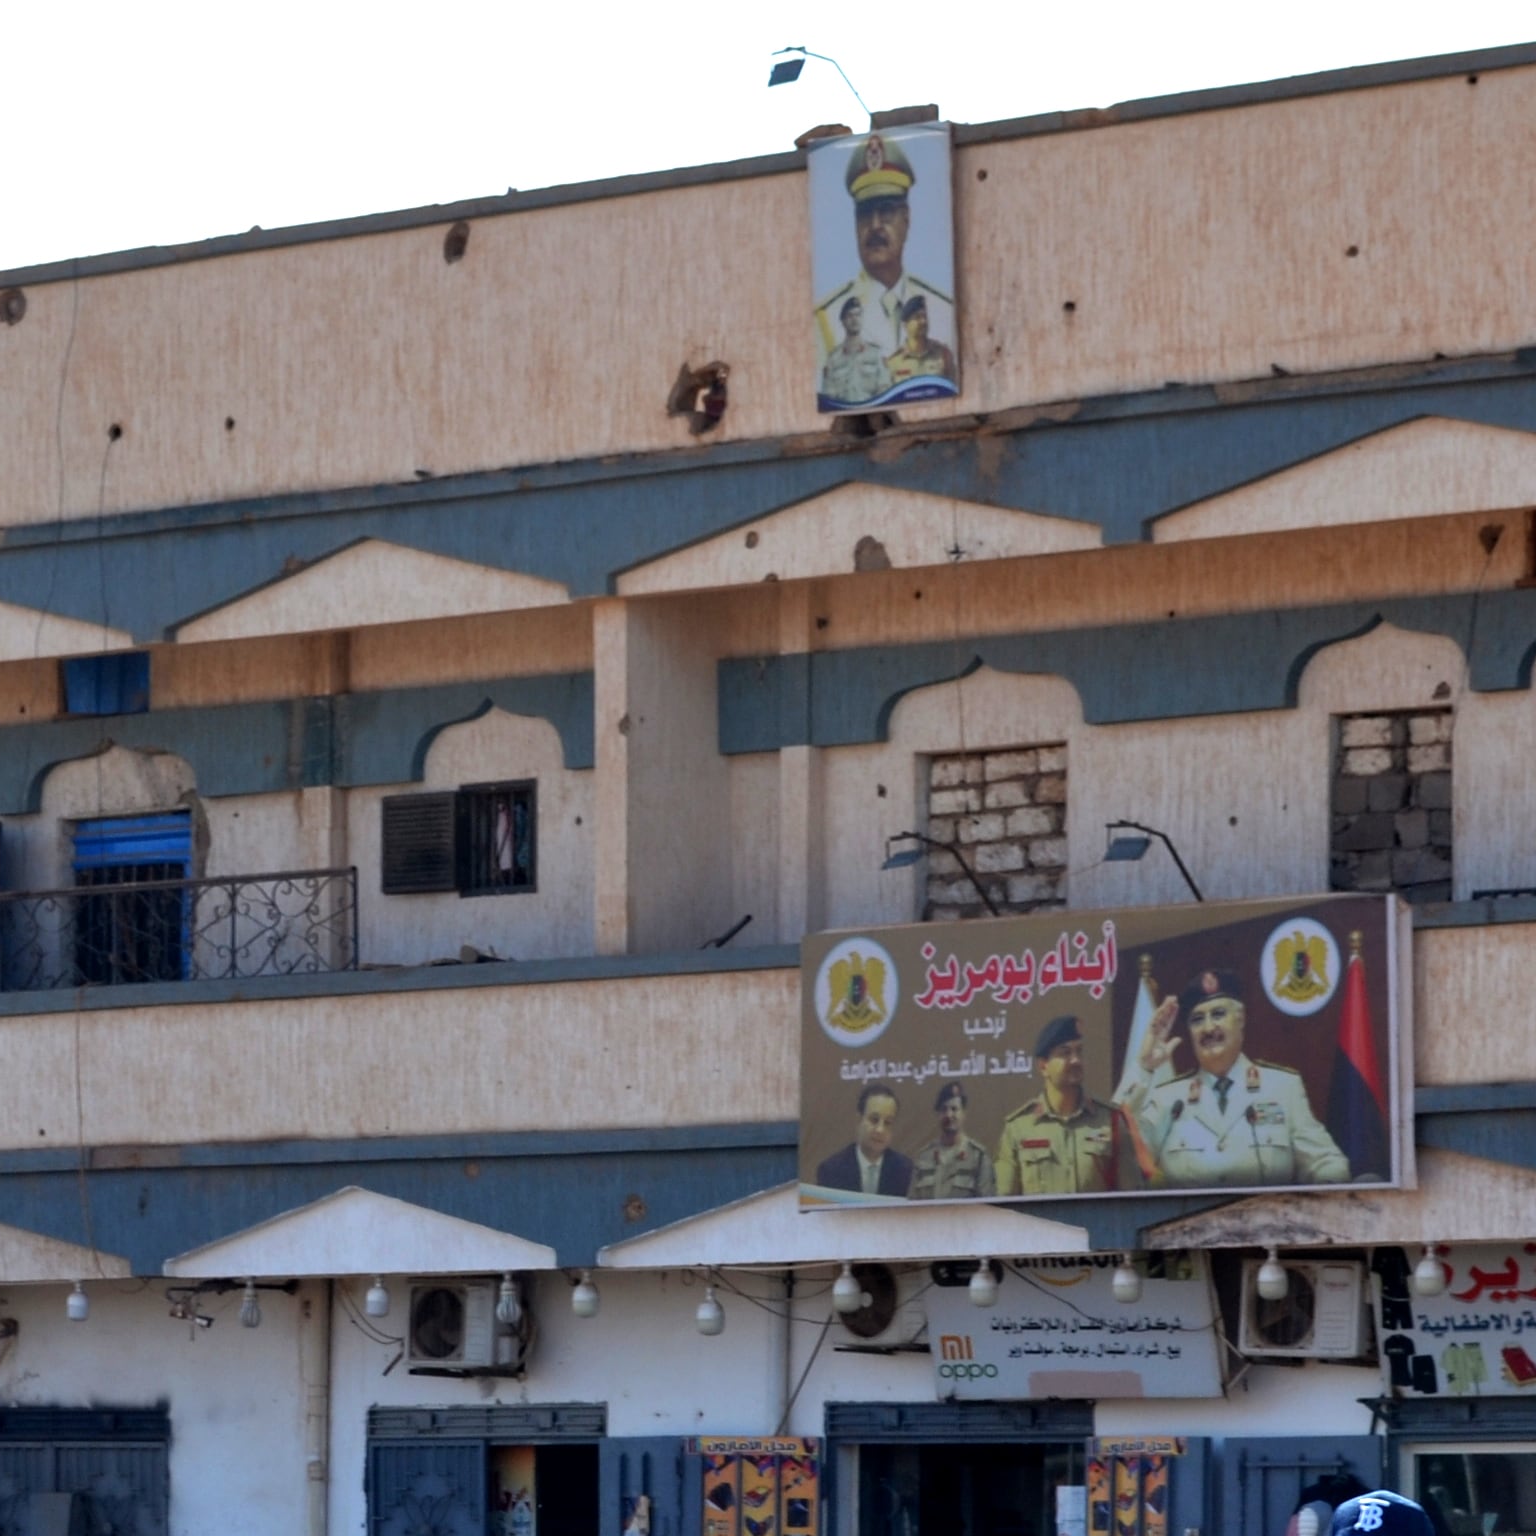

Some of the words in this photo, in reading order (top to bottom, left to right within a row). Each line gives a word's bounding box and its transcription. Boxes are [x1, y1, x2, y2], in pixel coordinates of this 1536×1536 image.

[1039, 920, 1117, 999] أبناء
[914, 942, 1035, 1009] بومريز
[963, 1011, 1007, 1038] ترحب
[887, 1060, 912, 1083] عيد
[913, 1055, 938, 1085] في
[939, 1049, 986, 1077] الأمة
[989, 1050, 1033, 1079] بقائد
[939, 1363, 999, 1382] oppo
